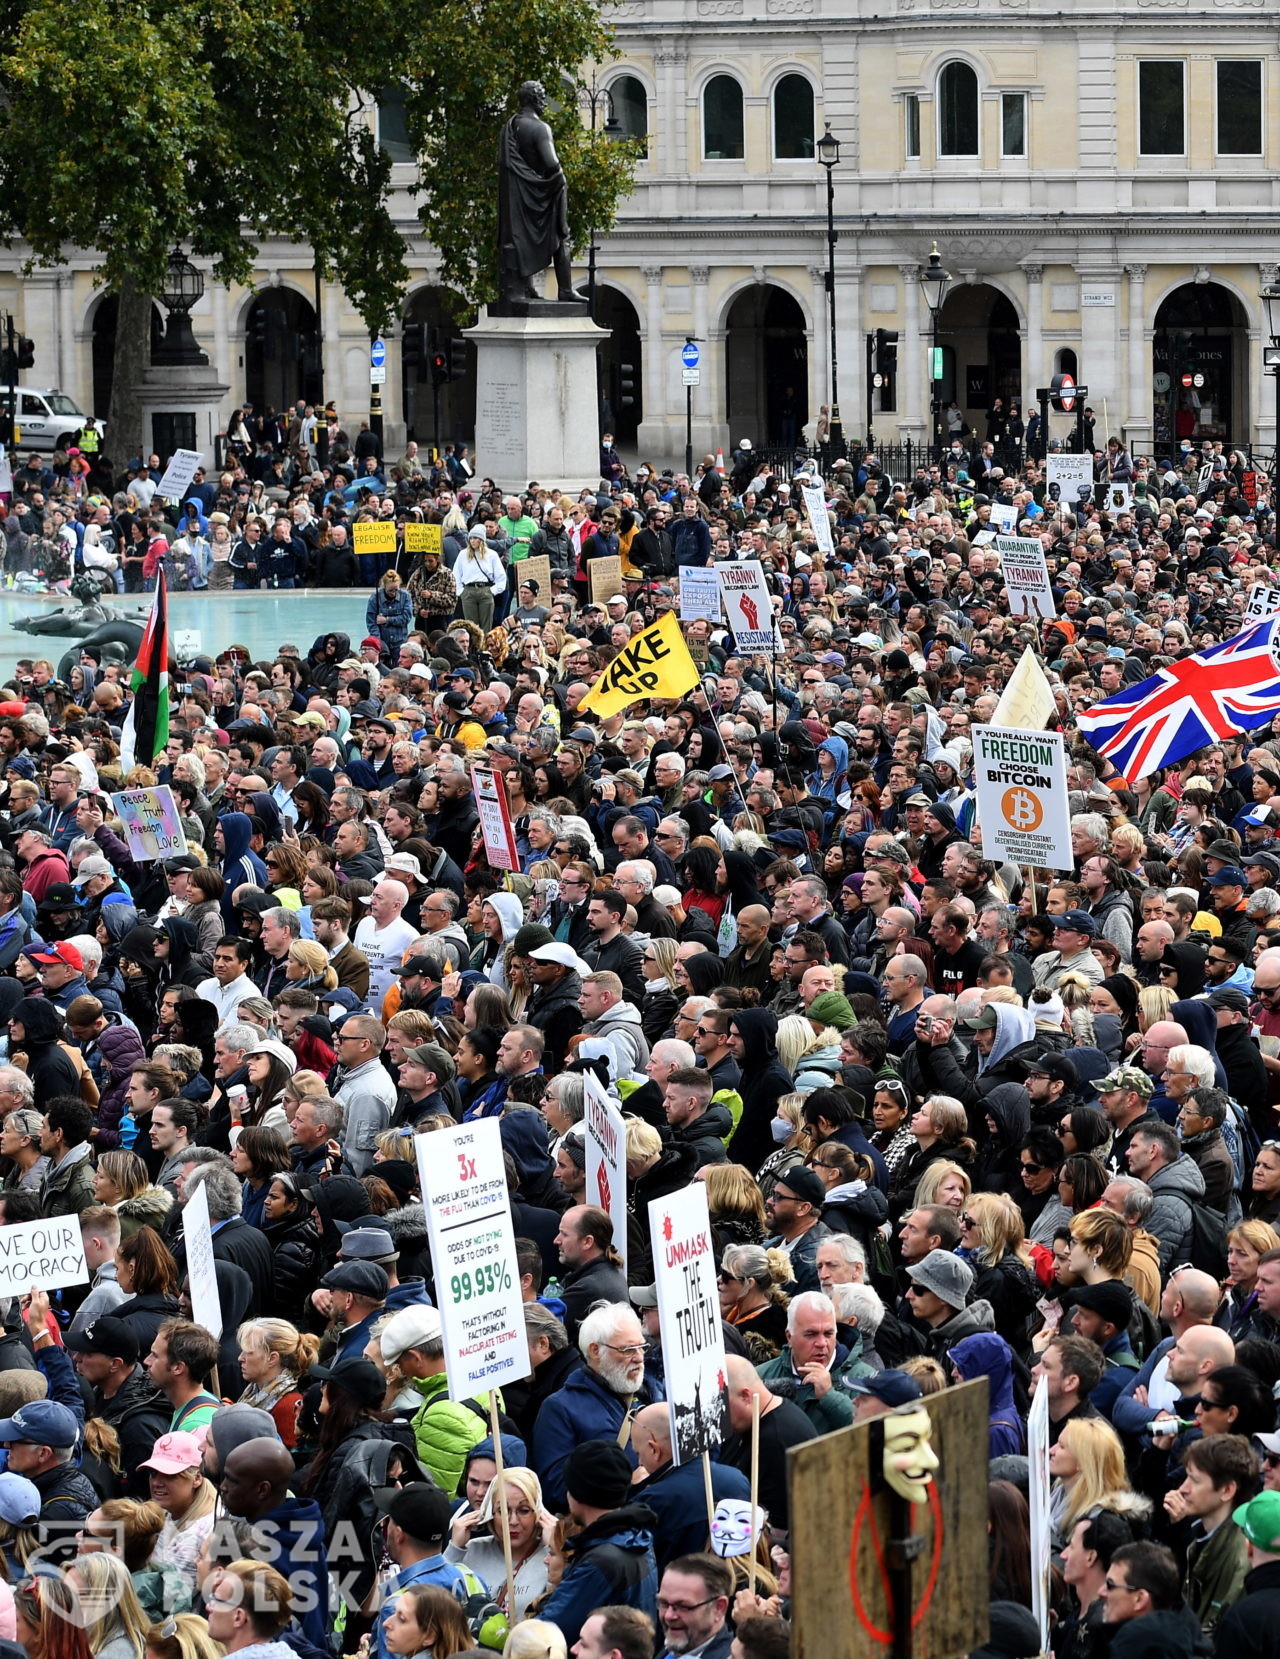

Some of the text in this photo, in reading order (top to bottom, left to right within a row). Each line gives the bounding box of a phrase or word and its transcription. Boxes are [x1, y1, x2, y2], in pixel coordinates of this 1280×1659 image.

[1153, 349, 1222, 360] Waeones
[355, 534, 396, 545] FREEDOM
[1000, 540, 1040, 554] QUARANTINE
[720, 570, 757, 584] TYRANNY
[1004, 567, 1044, 582] TYRANNY
[1248, 602, 1262, 615] IS
[619, 672, 658, 694] UP
[1002, 733, 1032, 742] REALLY
[1035, 736, 1058, 745] WANT
[981, 739, 1053, 766] FREEDOM
[999, 763, 1039, 774] CHOOSE
[987, 770, 1052, 789] BITCOIN
[121, 794, 150, 808] Peace
[129, 822, 162, 835] Freedom
[998, 830, 1052, 843] CENSORSHIP RESISTANT
[994, 837, 1056, 851] DECENTRALISED CURRENCY
[1005, 846, 1047, 858] UNCONFISCATABLE
[1008, 854, 1046, 865] PERMISSIONLESS
[362, 942, 380, 950] VACCINE
[587, 1092, 617, 1159] TYRANNY
[453, 1134, 474, 1147] YOU'RE
[458, 1154, 478, 1181] 3x
[432, 1178, 504, 1205] MORE LIKELY TO DIE FROM
[440, 1192, 503, 1216] THE FLU THAN COVID-19
[31, 1228, 76, 1254] OUR
[448, 1229, 503, 1253] ODDS OF NOT DYING
[454, 1244, 500, 1265] DUE TO COVID-19
[666, 1231, 709, 1268] UNMASK
[451, 1258, 511, 1304] 99.93%
[682, 1262, 703, 1303] THE
[462, 1306, 507, 1330] THAT'S WITHOUT
[468, 1323, 500, 1341] FACTORING
[676, 1298, 717, 1359] TRUTH
[458, 1330, 518, 1358] INACCURATE TESTING
[484, 1351, 496, 1362] AND
[468, 1365, 486, 1381] FALSE
